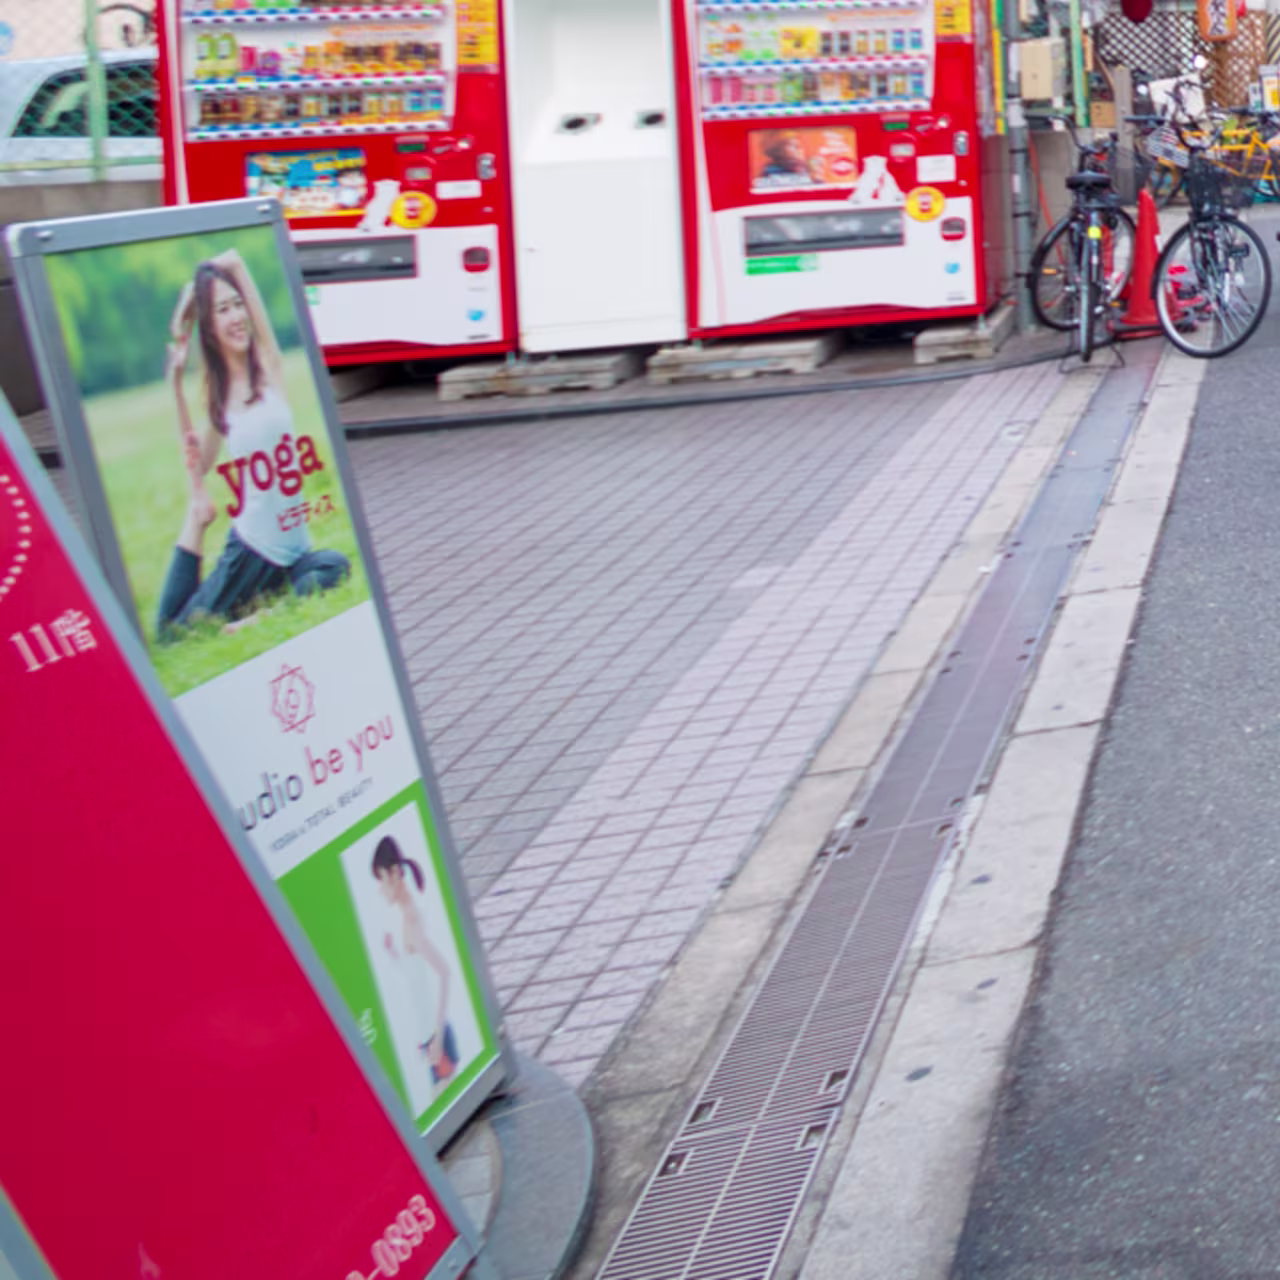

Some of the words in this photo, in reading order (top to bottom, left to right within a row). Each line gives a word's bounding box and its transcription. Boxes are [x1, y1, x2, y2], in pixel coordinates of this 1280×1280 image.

[216, 433, 324, 517] yoga
[9, 608, 97, 673] 11階
[241, 772, 303, 831] udio
[304, 745, 344, 787] be
[347, 714, 394, 772] you
[345, 1194, 436, 1280] -0893
